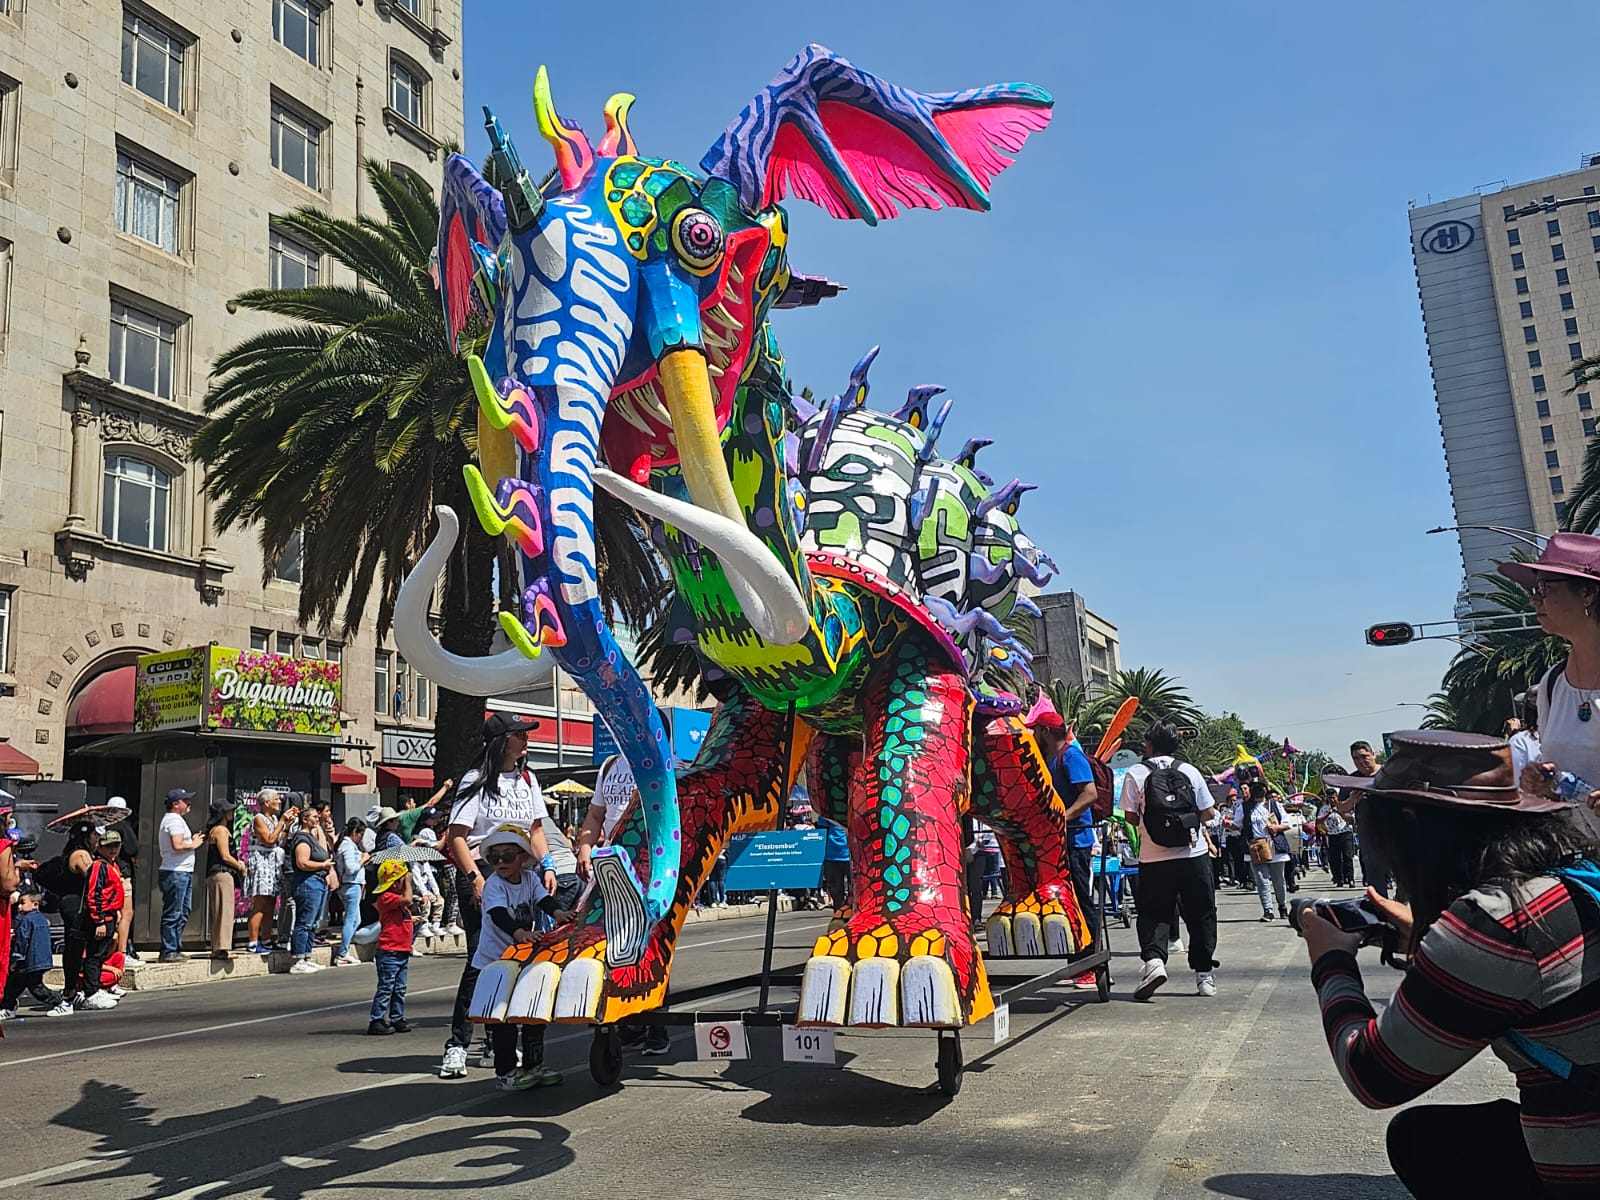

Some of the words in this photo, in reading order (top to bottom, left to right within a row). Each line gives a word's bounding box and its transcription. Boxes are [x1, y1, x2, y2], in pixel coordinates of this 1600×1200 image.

[215, 668, 336, 708] Bugambilia
[397, 738, 436, 760] OXXO
[606, 773, 634, 784] MUS
[498, 788, 529, 800] USEO
[604, 784, 616, 795] DE
[795, 1034, 820, 1051] 101
